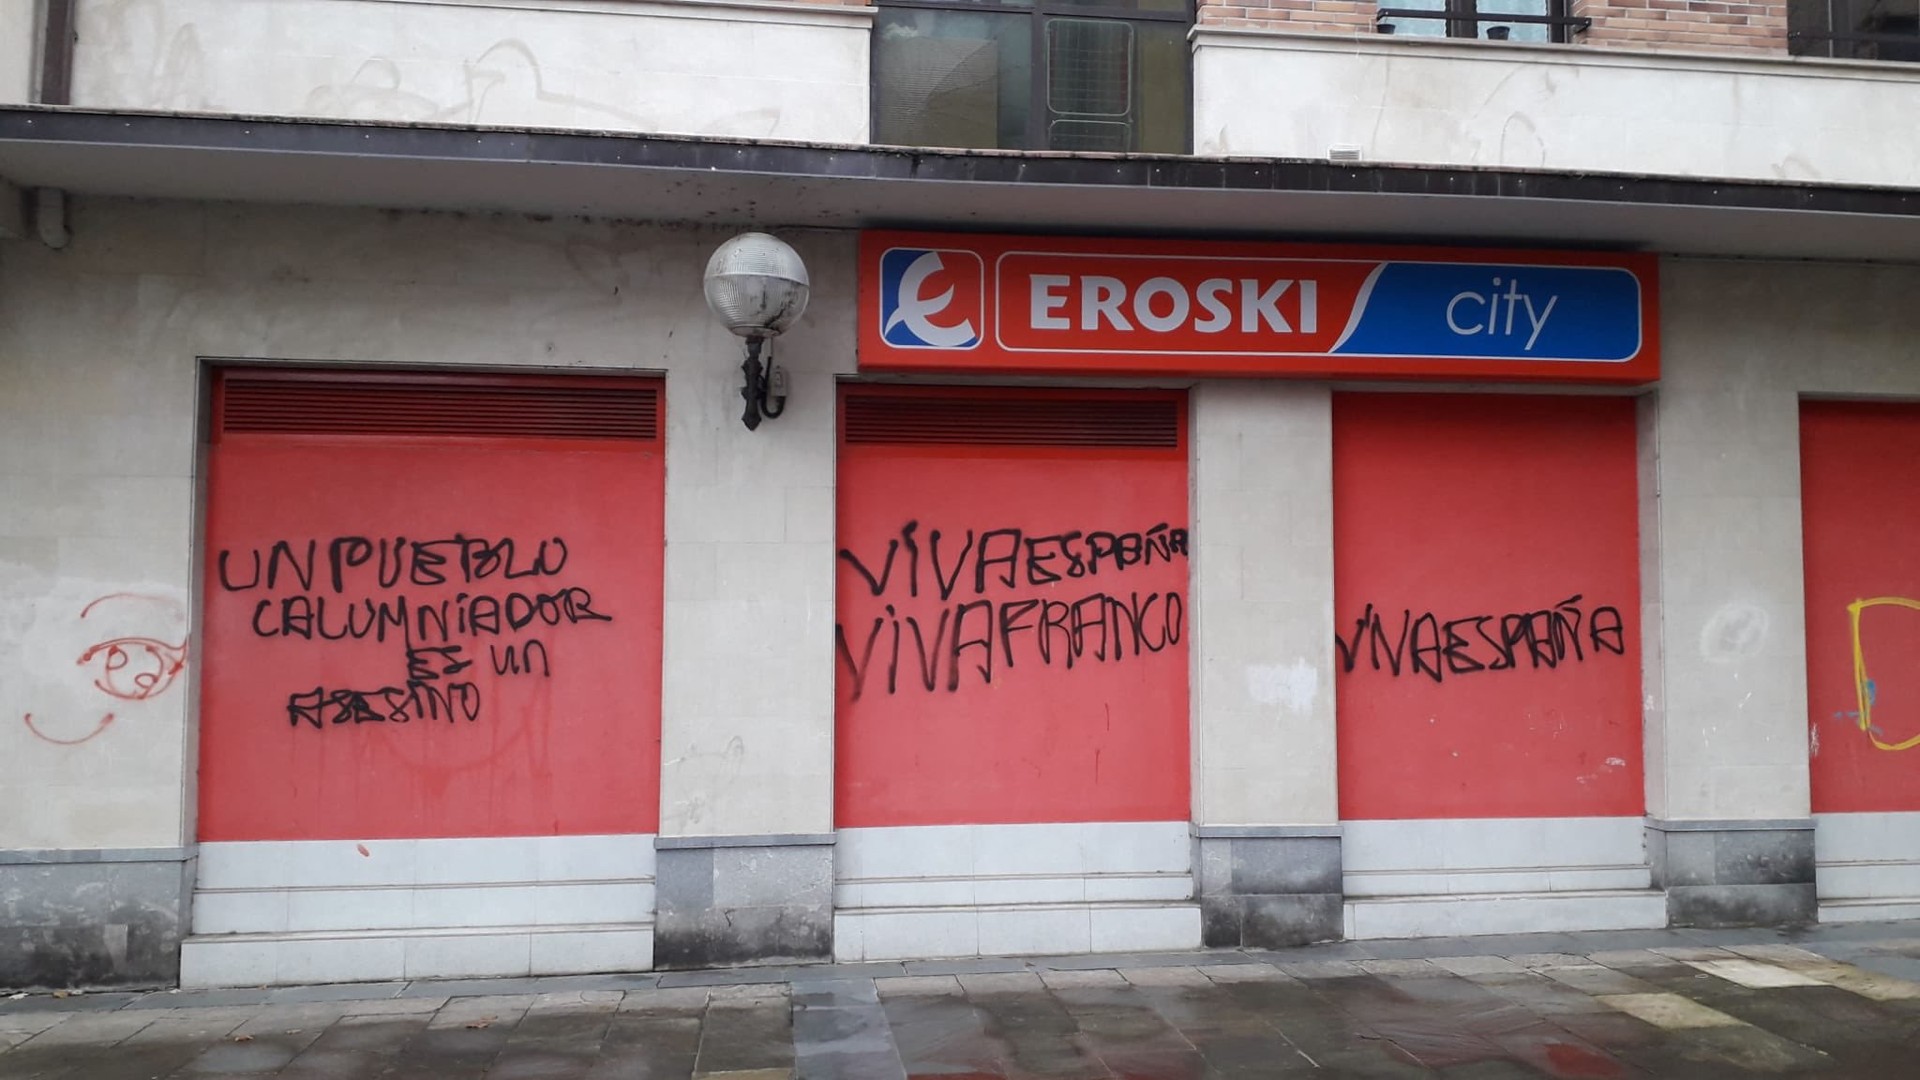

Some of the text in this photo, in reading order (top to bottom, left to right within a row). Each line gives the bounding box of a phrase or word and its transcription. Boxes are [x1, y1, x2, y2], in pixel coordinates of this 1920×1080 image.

[1029, 274, 1558, 350] EROSKI city
[999, 592, 1182, 670] FRANCO
